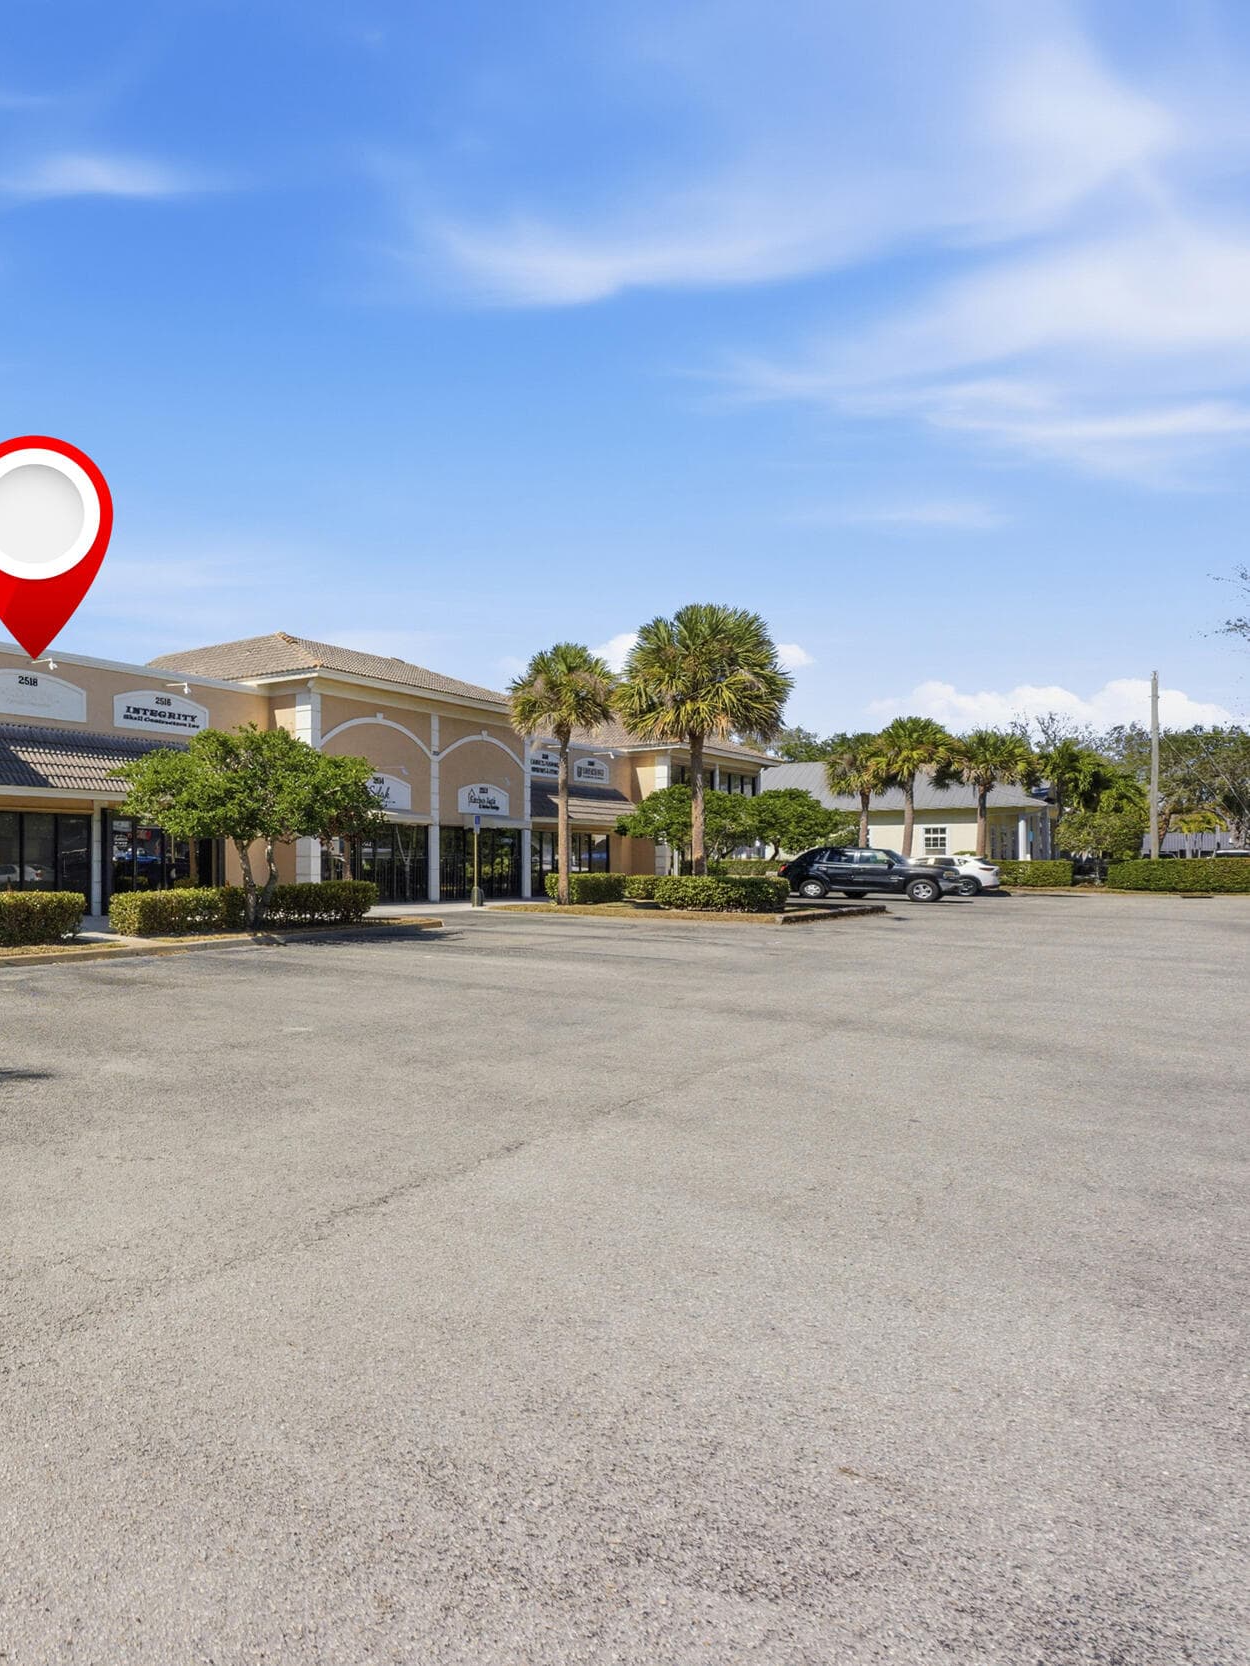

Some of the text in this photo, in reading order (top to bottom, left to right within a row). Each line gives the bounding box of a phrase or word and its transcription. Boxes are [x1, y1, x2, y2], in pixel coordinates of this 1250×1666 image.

[18, 675, 38, 687] 2518
[155, 696, 172, 706] 2516
[125, 706, 197, 723] INTEGRITY
